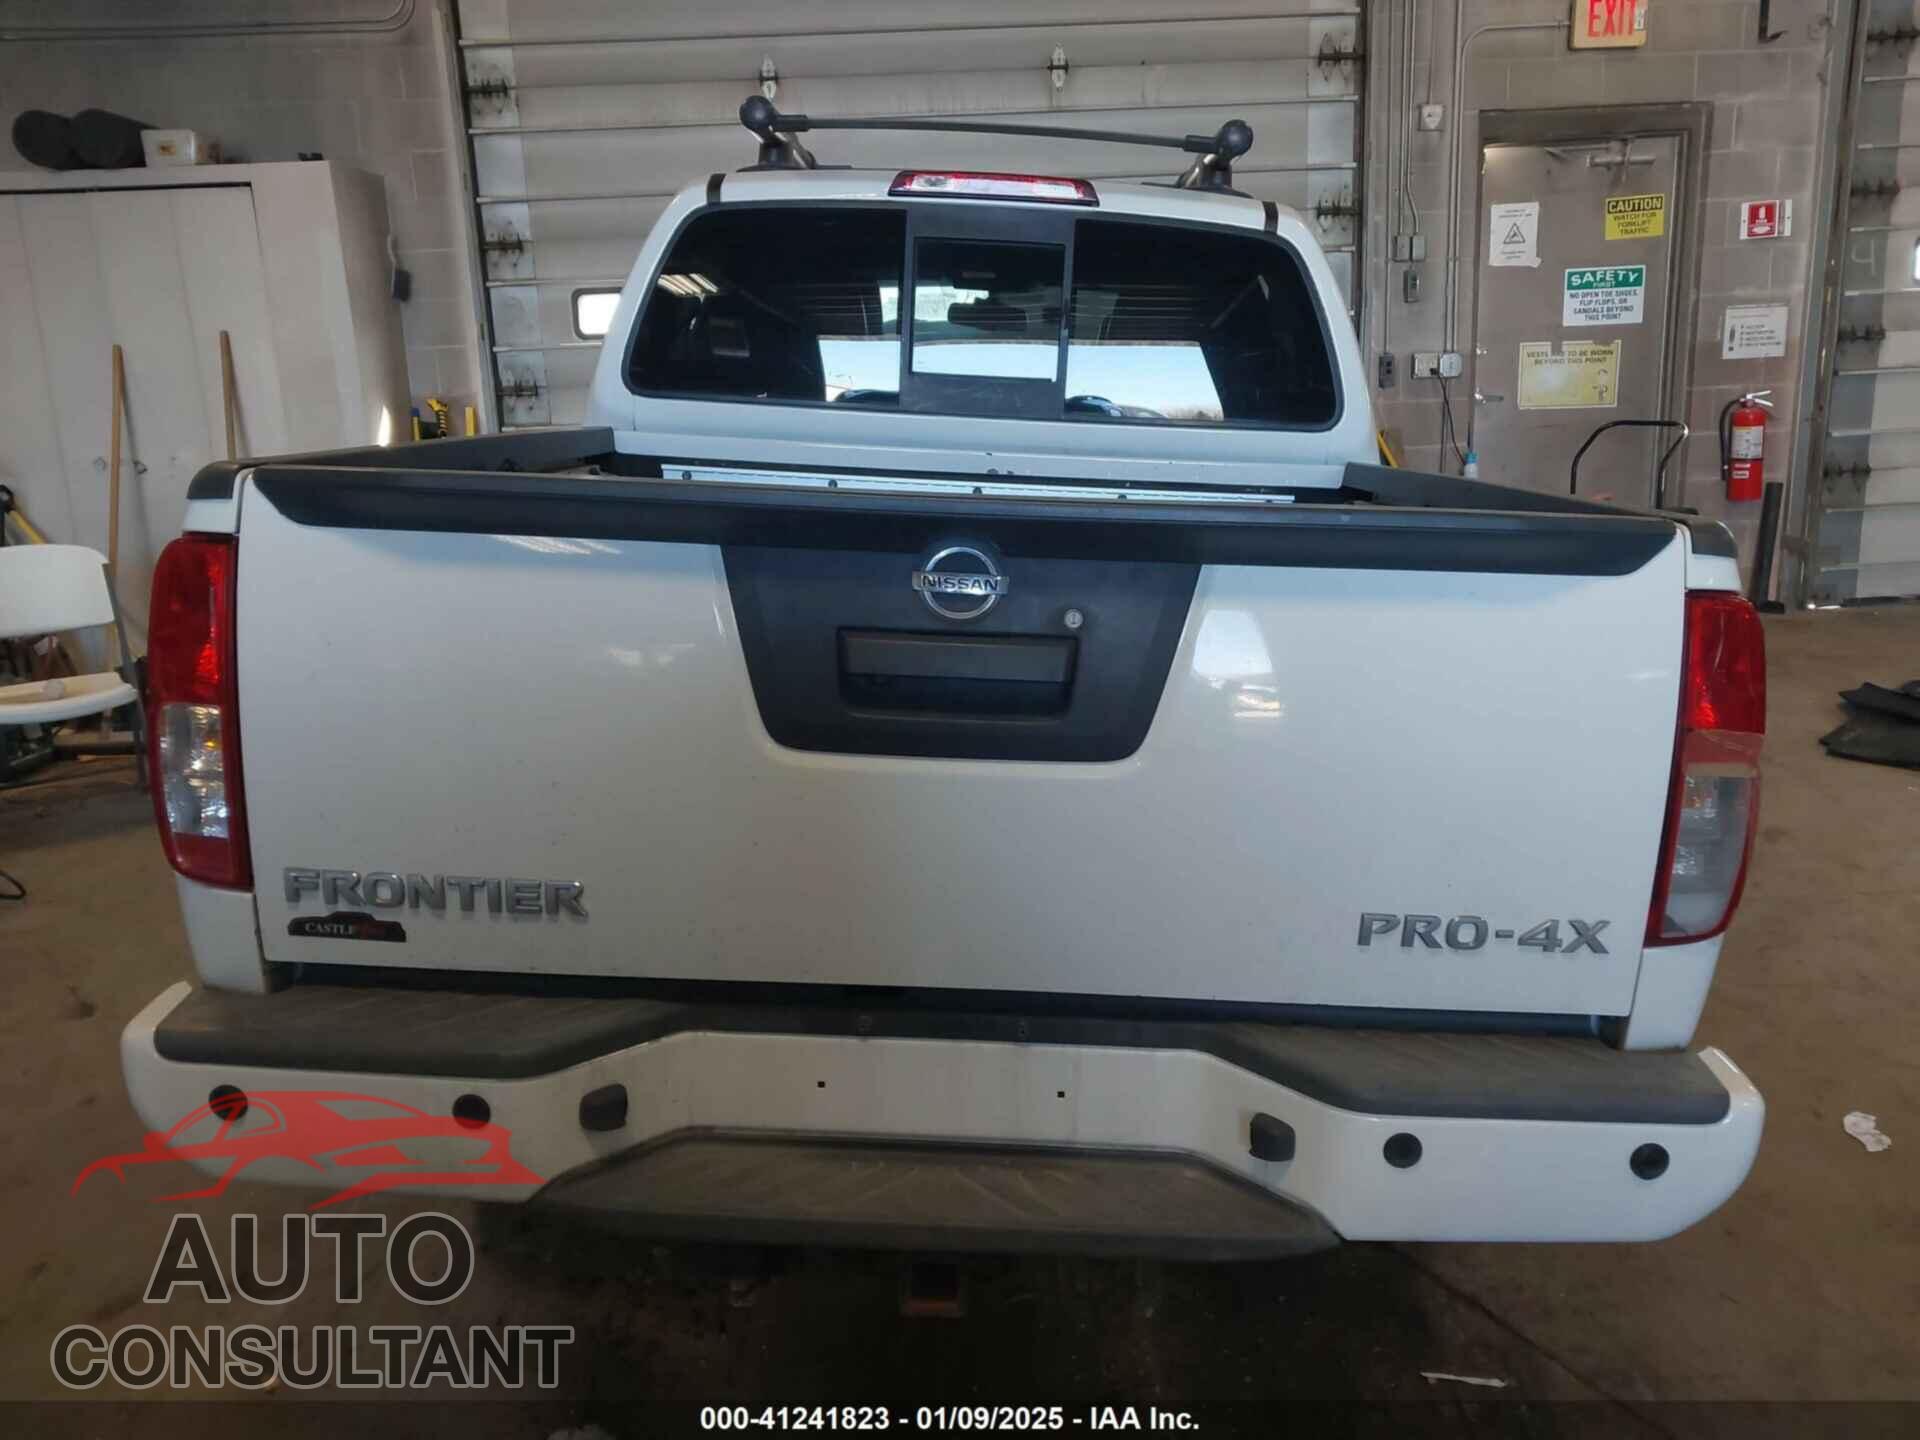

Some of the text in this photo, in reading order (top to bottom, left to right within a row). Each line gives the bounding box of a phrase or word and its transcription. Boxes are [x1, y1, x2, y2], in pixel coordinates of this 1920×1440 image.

[1588, 0, 1636, 37] EXIT
[1608, 198, 1662, 212] CAUTION
[1620, 226, 1649, 236] TRAFFIC
[1570, 270, 1639, 286] SAFETY
[1593, 280, 1616, 289] FIRST
[1581, 291, 1600, 299] OPEN
[1601, 290, 1614, 298] TOE
[1573, 305, 1634, 314] SANDALS BEYOND
[1601, 313, 1622, 321] POINT
[1590, 348, 1614, 356] WORN
[1534, 358, 1566, 366] BEYOND
[1585, 356, 1608, 364] POINT
[922, 574, 999, 593] NISSAN
[284, 866, 589, 918] FRONTIER
[1357, 912, 1612, 955] PRO-4X
